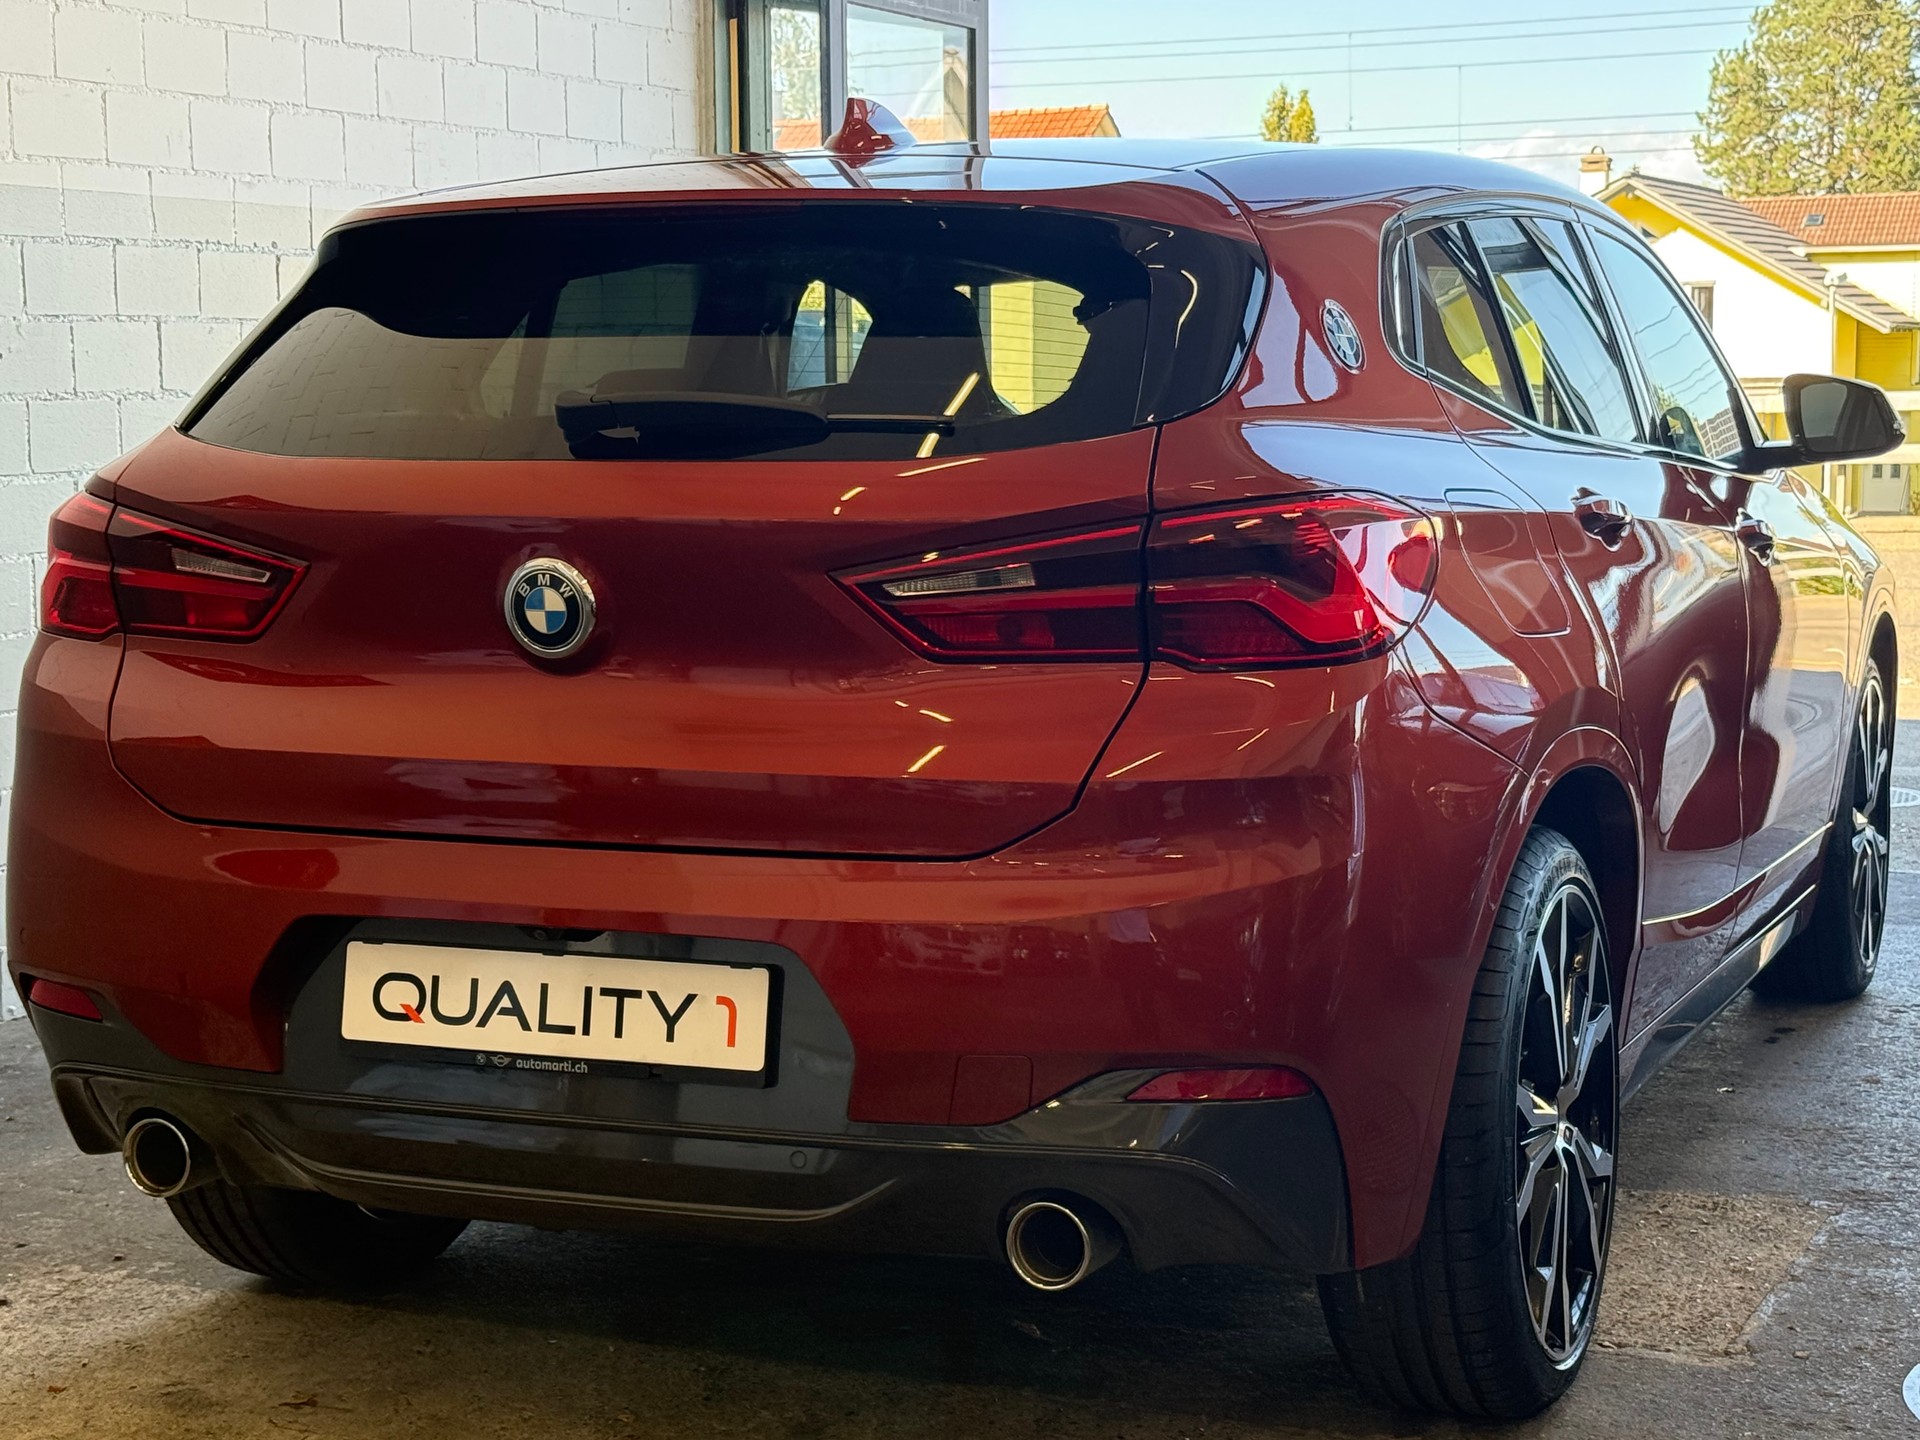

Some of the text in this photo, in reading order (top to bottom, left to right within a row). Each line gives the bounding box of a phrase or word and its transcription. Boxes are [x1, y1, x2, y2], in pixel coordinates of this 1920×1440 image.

[518, 574, 573, 597] BMW
[372, 971, 738, 1048] QUALITY 1
[516, 1059, 589, 1074] automarti.ch
